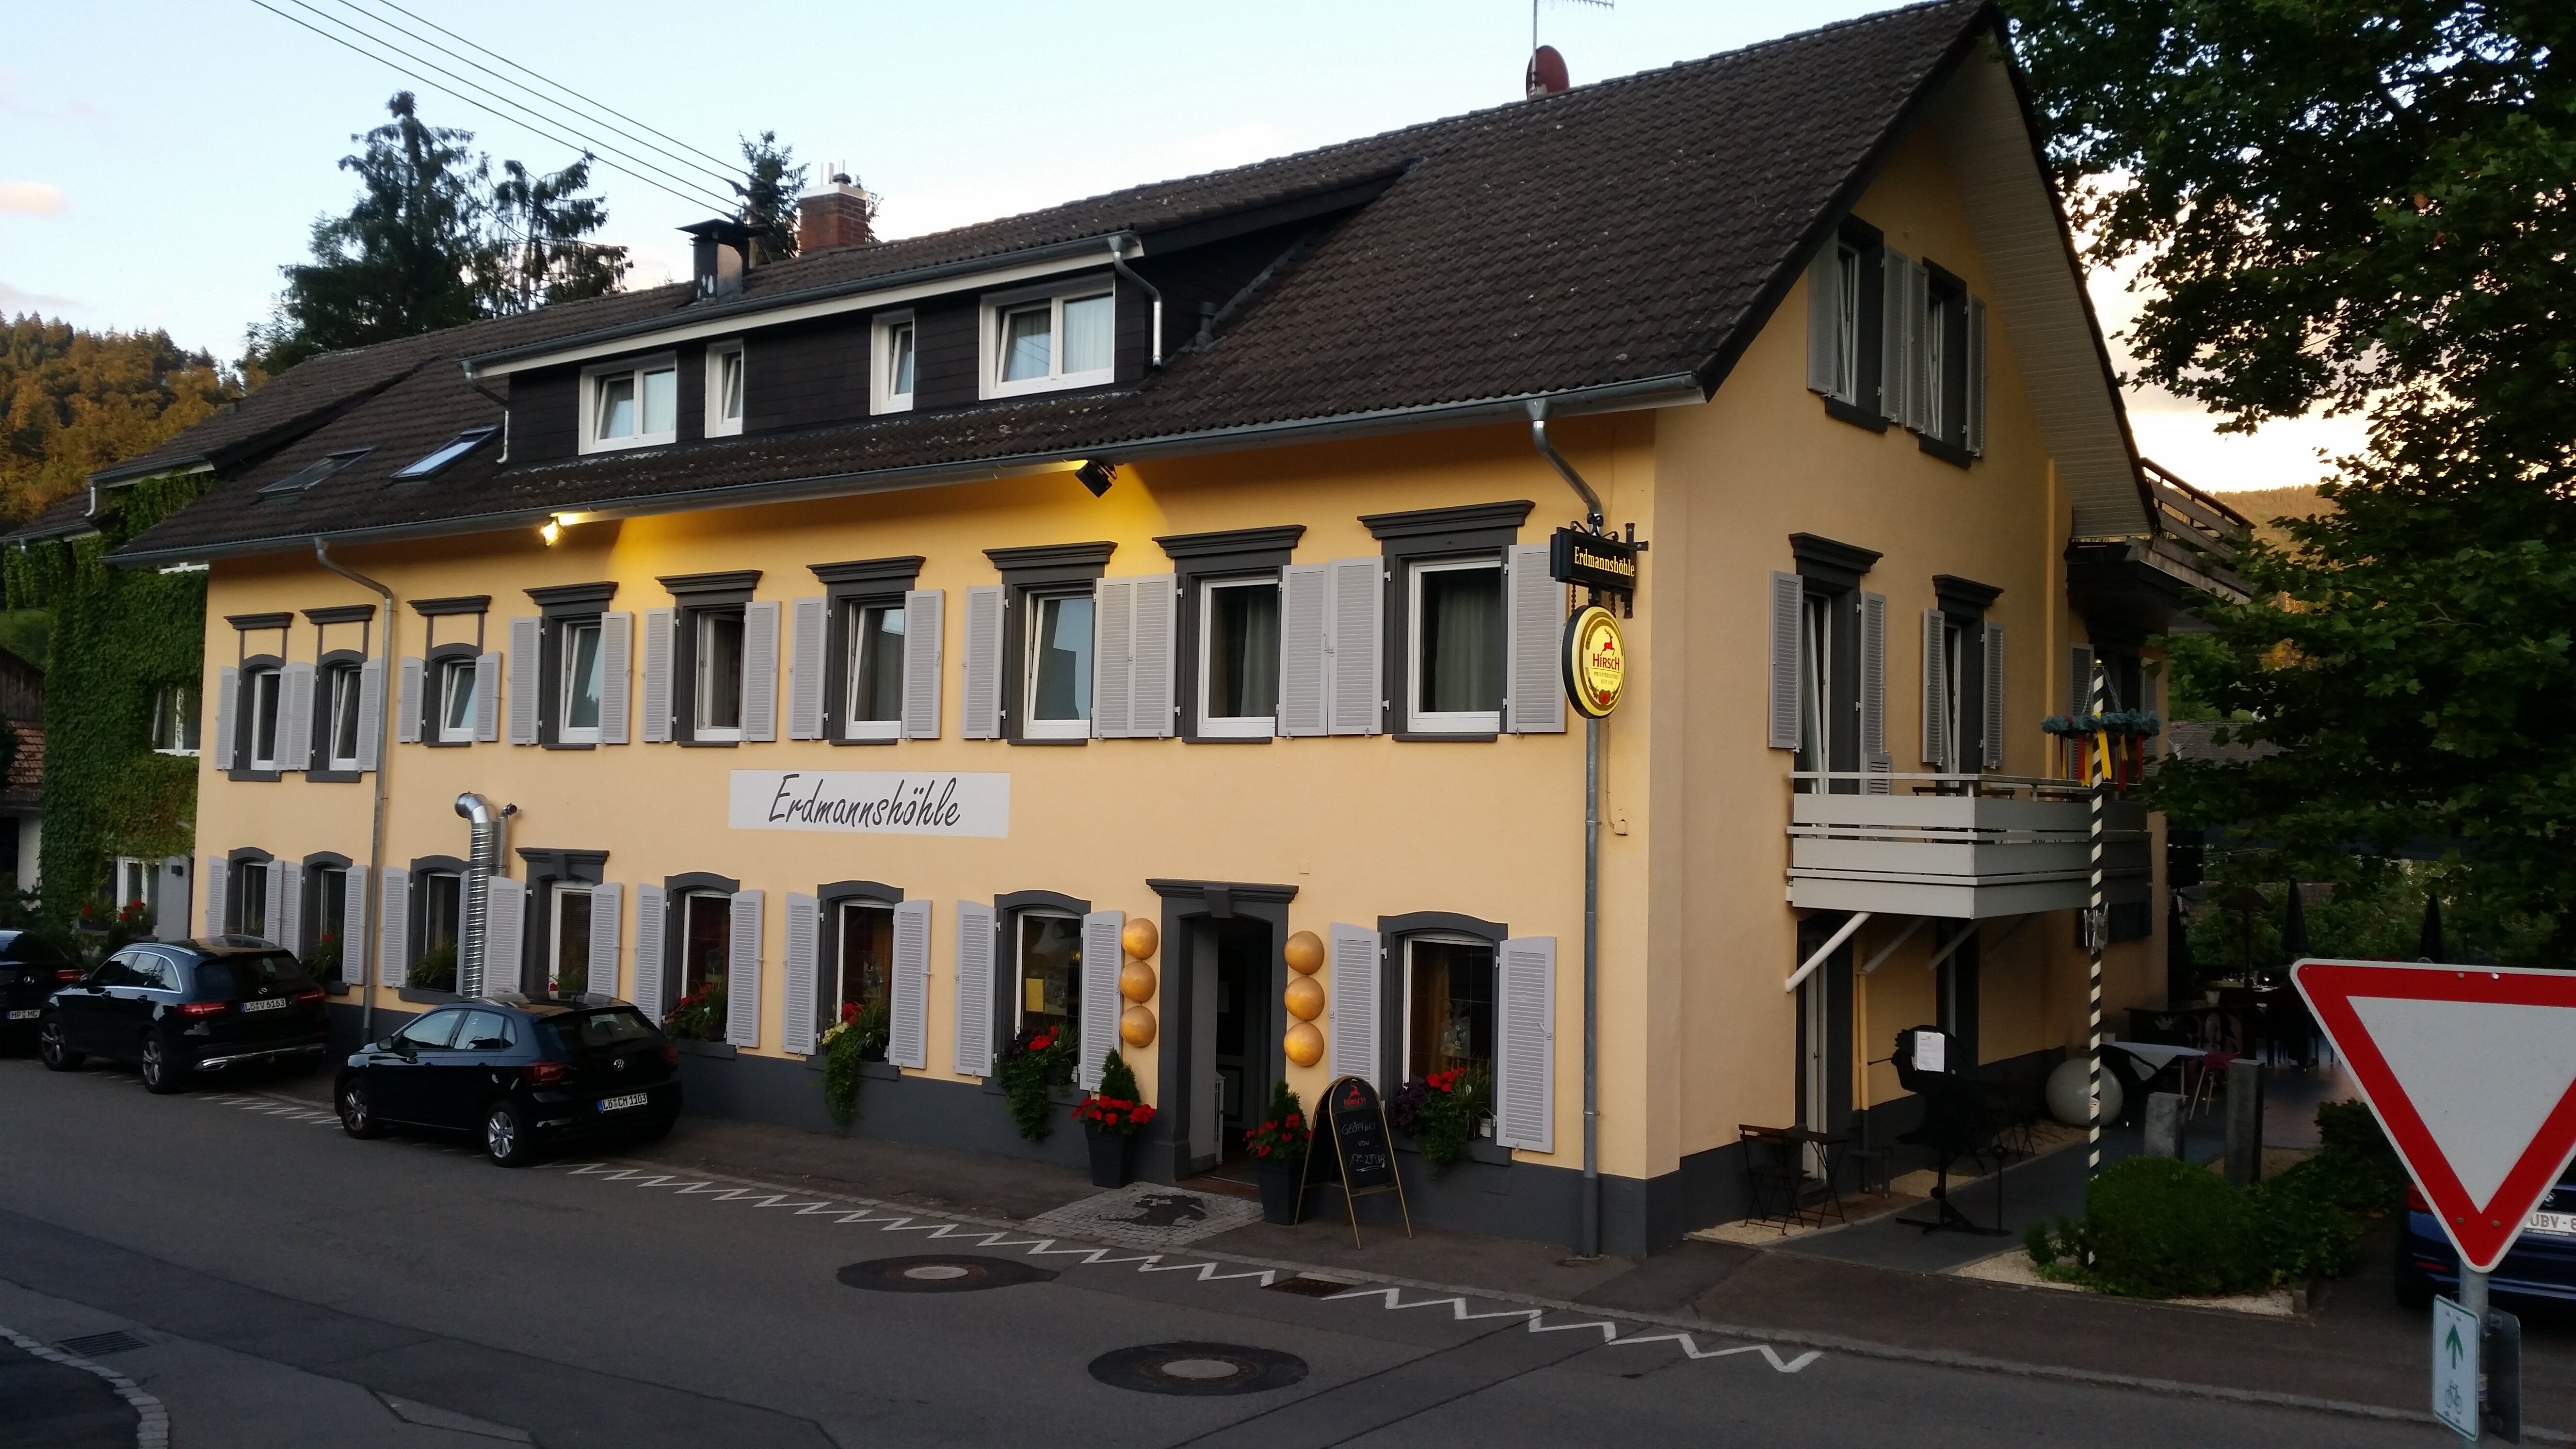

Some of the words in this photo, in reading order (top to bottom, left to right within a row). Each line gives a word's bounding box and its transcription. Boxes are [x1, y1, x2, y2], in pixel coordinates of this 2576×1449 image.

[1574, 546, 1635, 577] Erdmannshöhle
[768, 773, 960, 828] Erdmannshöhle
[266, 999, 285, 1008] 6163
[603, 1100, 612, 1110] LÖ
[618, 1097, 628, 1106] CM
[629, 1094, 646, 1105] 1103
